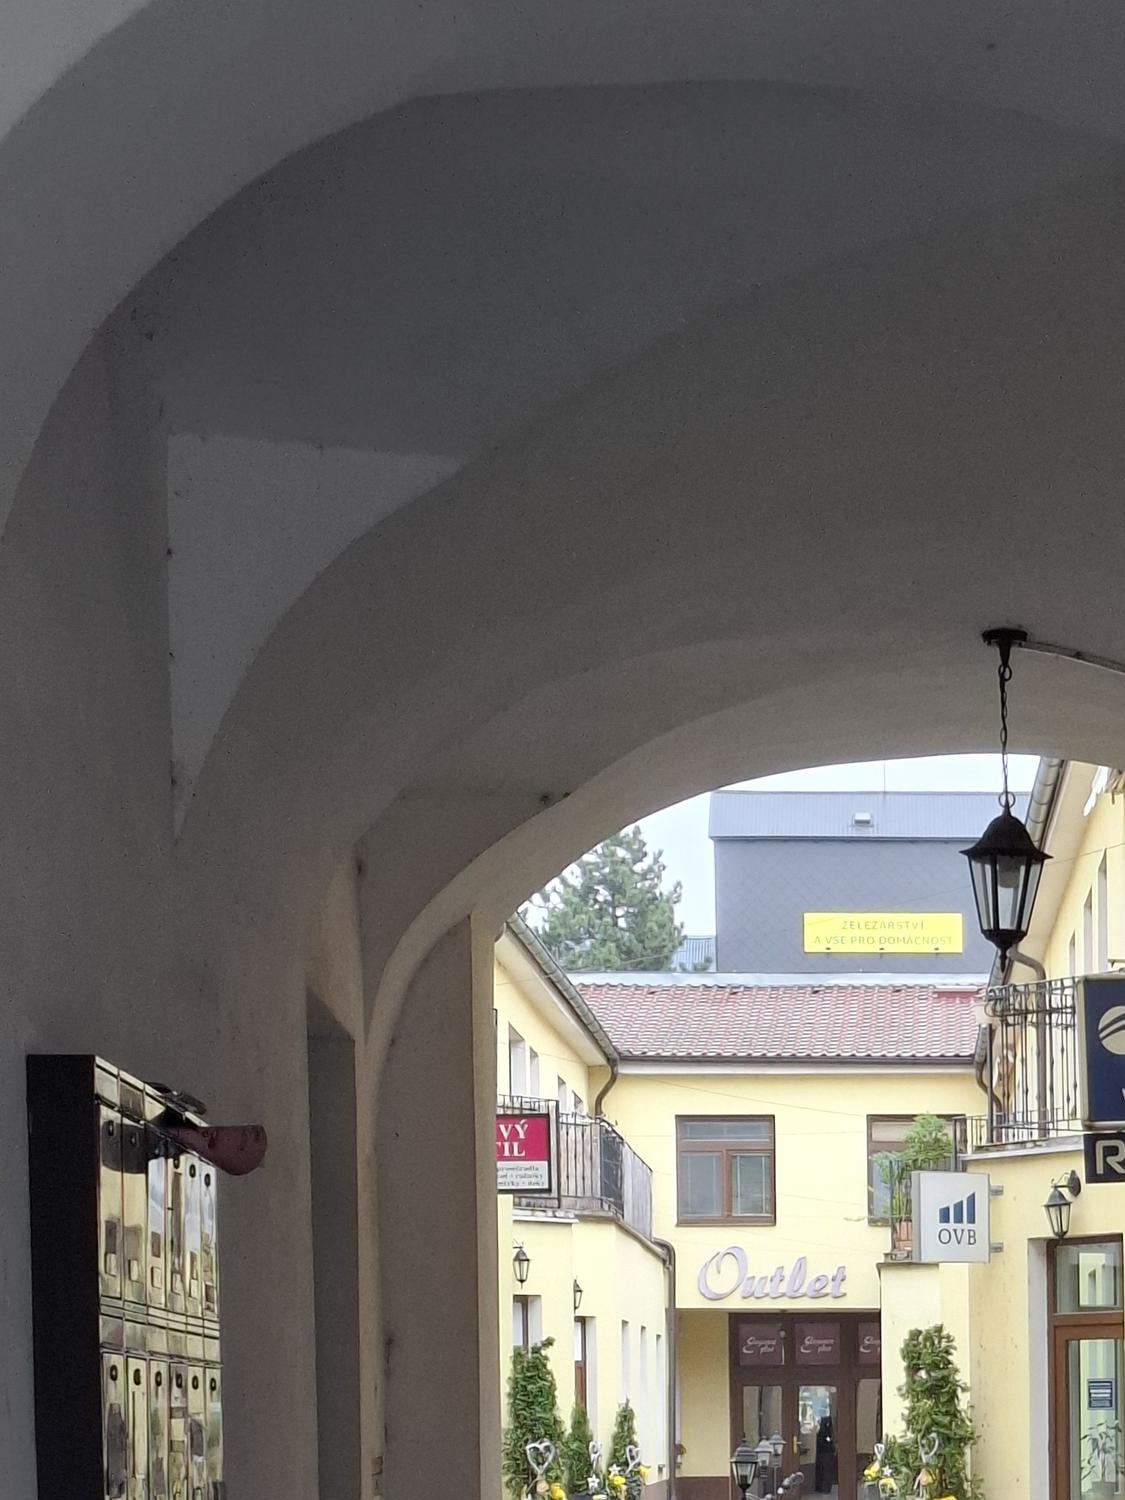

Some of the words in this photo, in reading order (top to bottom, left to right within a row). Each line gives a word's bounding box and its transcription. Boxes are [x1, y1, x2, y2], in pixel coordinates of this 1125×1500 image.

[850, 935, 876, 945] PRO
[938, 1228, 977, 1246] OVB
[697, 1245, 848, 1301] Outlet
